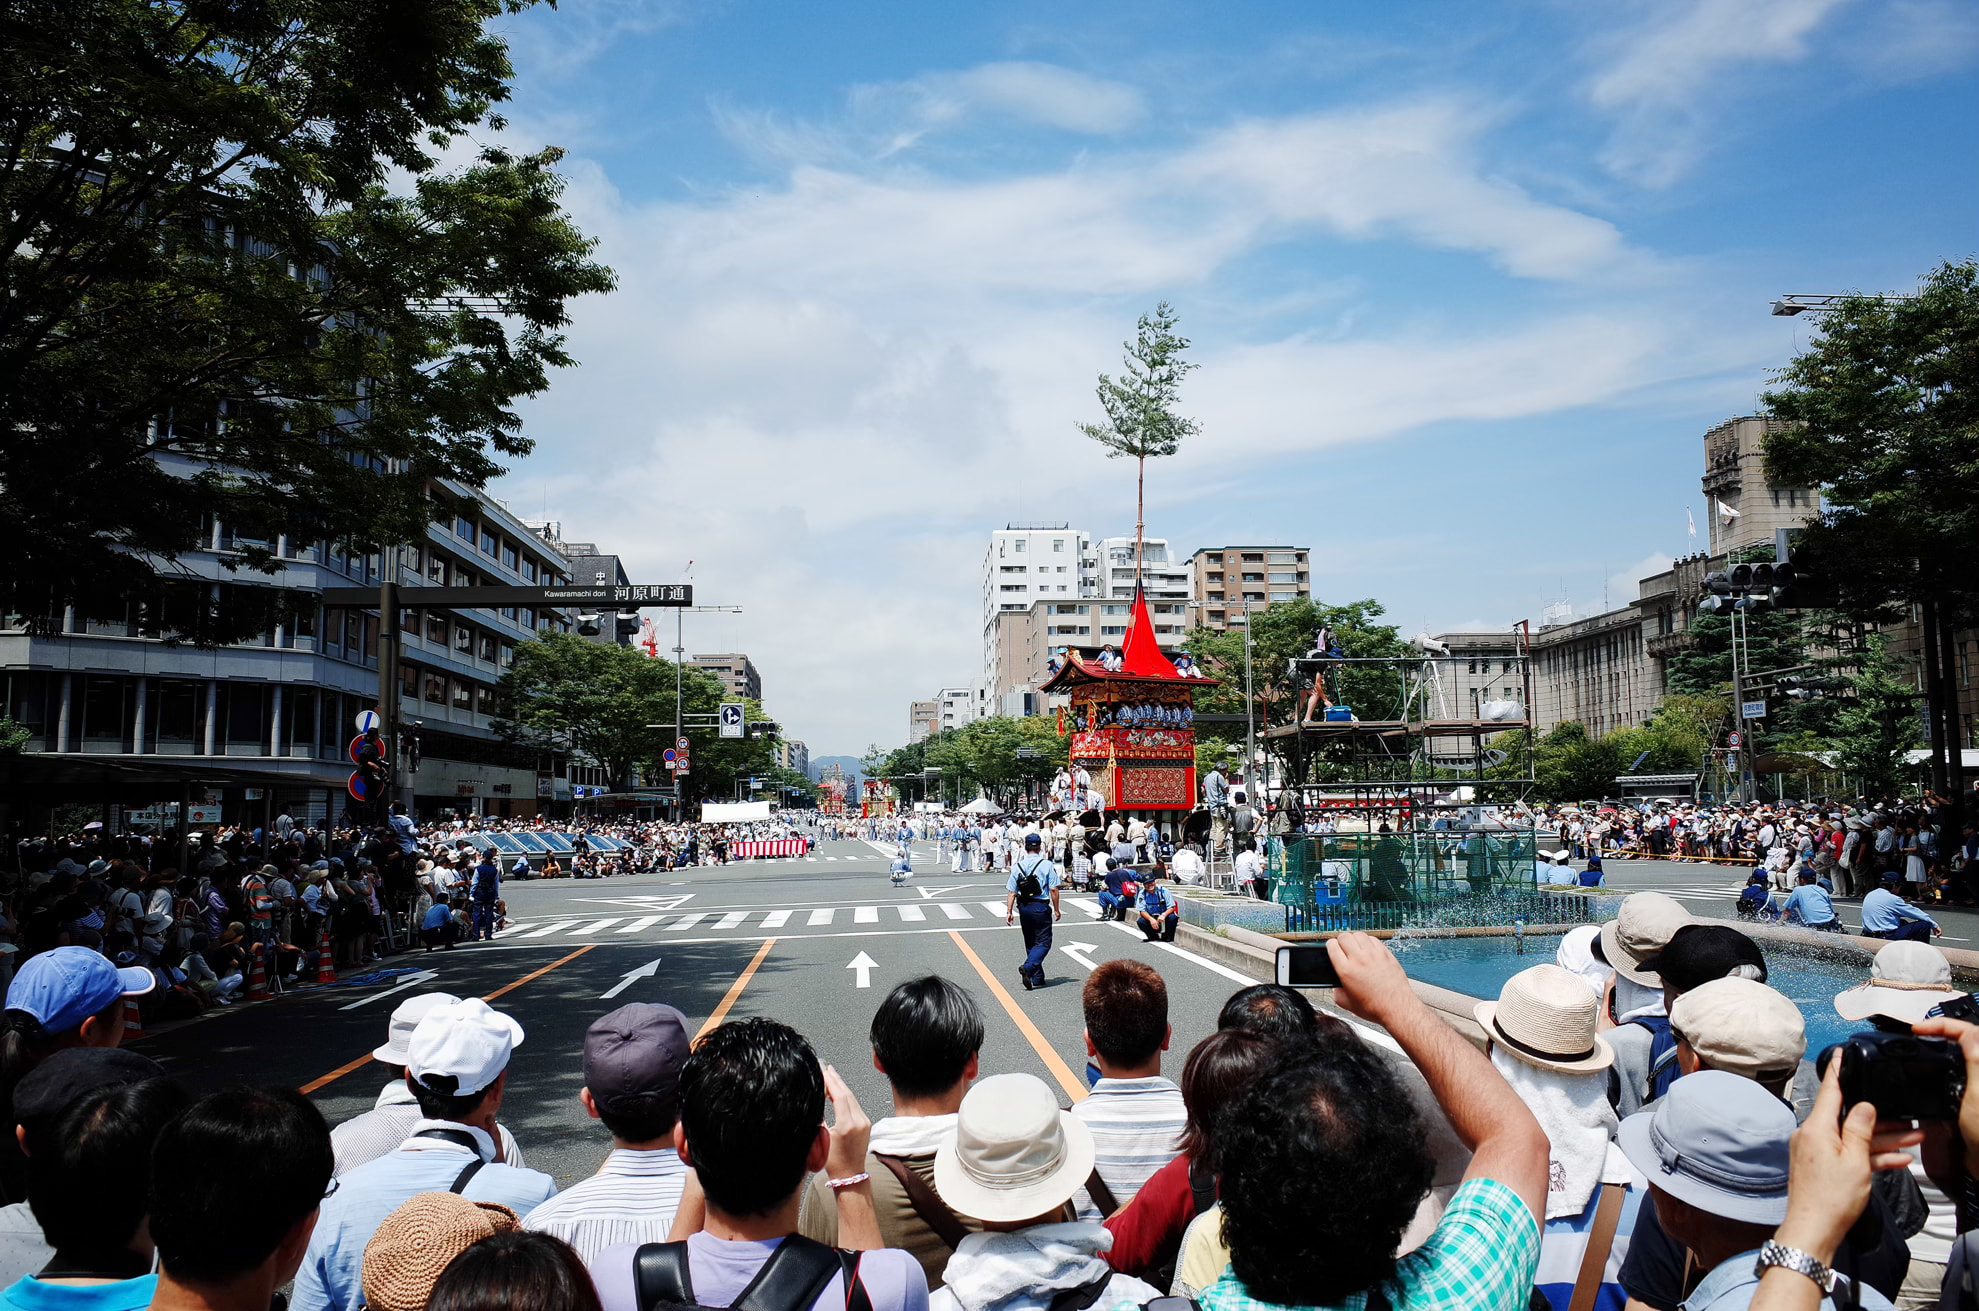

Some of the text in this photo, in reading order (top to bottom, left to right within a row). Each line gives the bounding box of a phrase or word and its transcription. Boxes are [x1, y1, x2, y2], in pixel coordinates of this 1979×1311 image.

[544, 590, 591, 598] Kawaramachi
[614, 585, 685, 600] 河原町通
